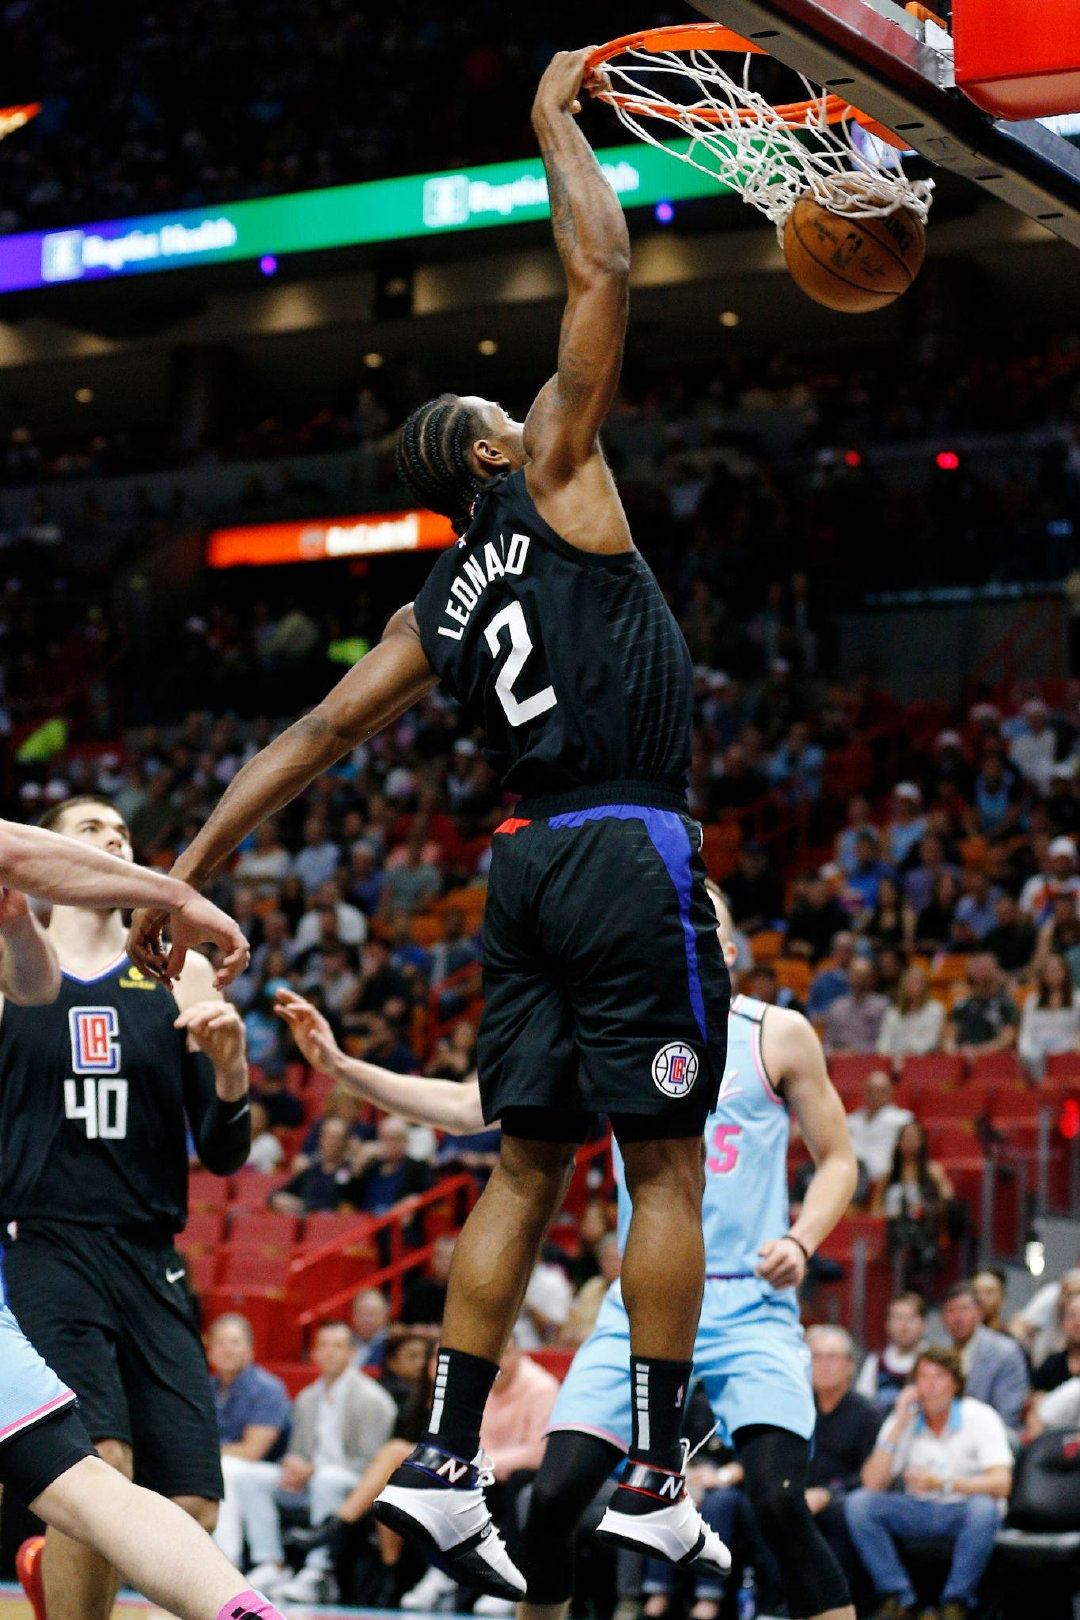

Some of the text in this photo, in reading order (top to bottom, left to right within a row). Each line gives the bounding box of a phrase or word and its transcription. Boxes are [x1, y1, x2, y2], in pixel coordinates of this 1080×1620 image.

[437, 533, 531, 641] LEONAD
[483, 600, 558, 727] 2
[64, 1078, 128, 1139] 40
[707, 1124, 742, 1174] 5
